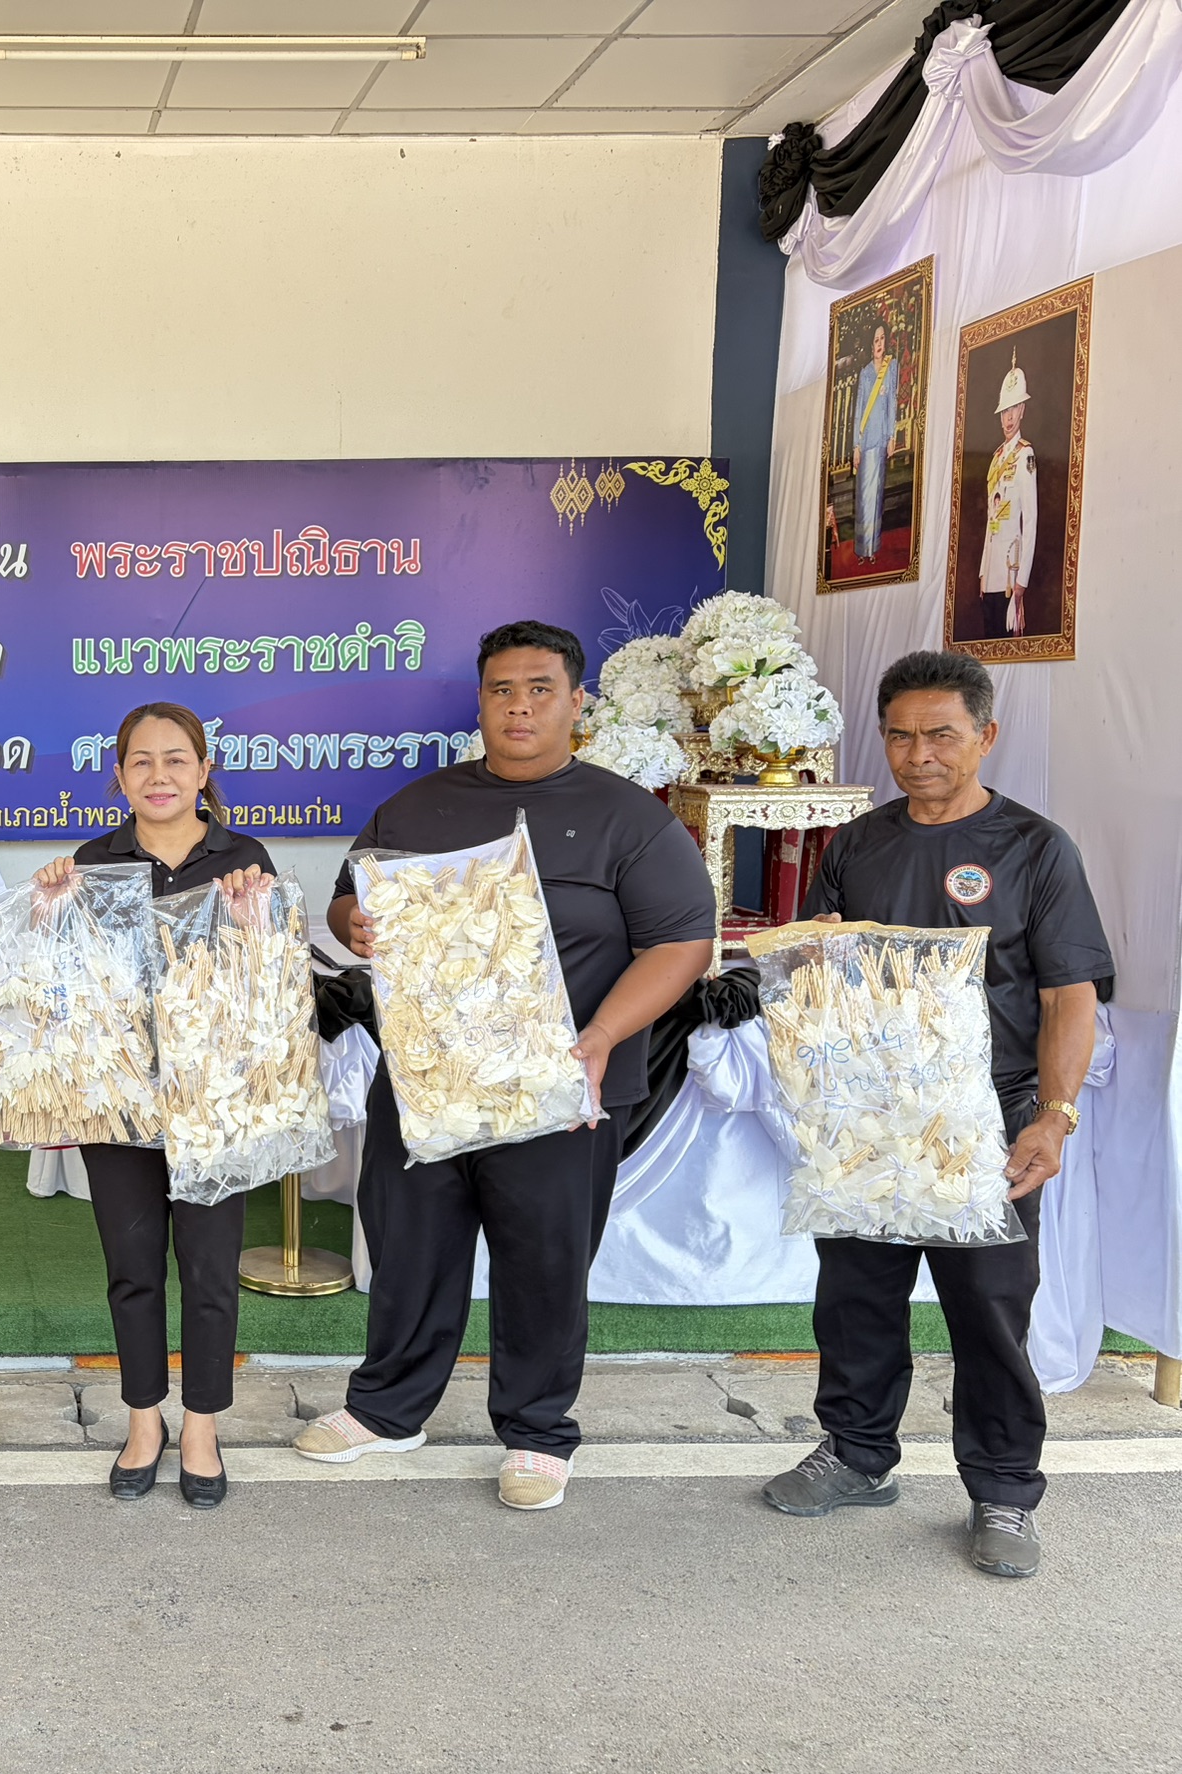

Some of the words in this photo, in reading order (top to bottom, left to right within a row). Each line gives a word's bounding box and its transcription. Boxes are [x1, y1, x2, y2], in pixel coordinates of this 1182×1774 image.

[70, 525, 421, 578] พระราชปณิธาน
[72, 619, 426, 674] แนวพระราชดำริ
